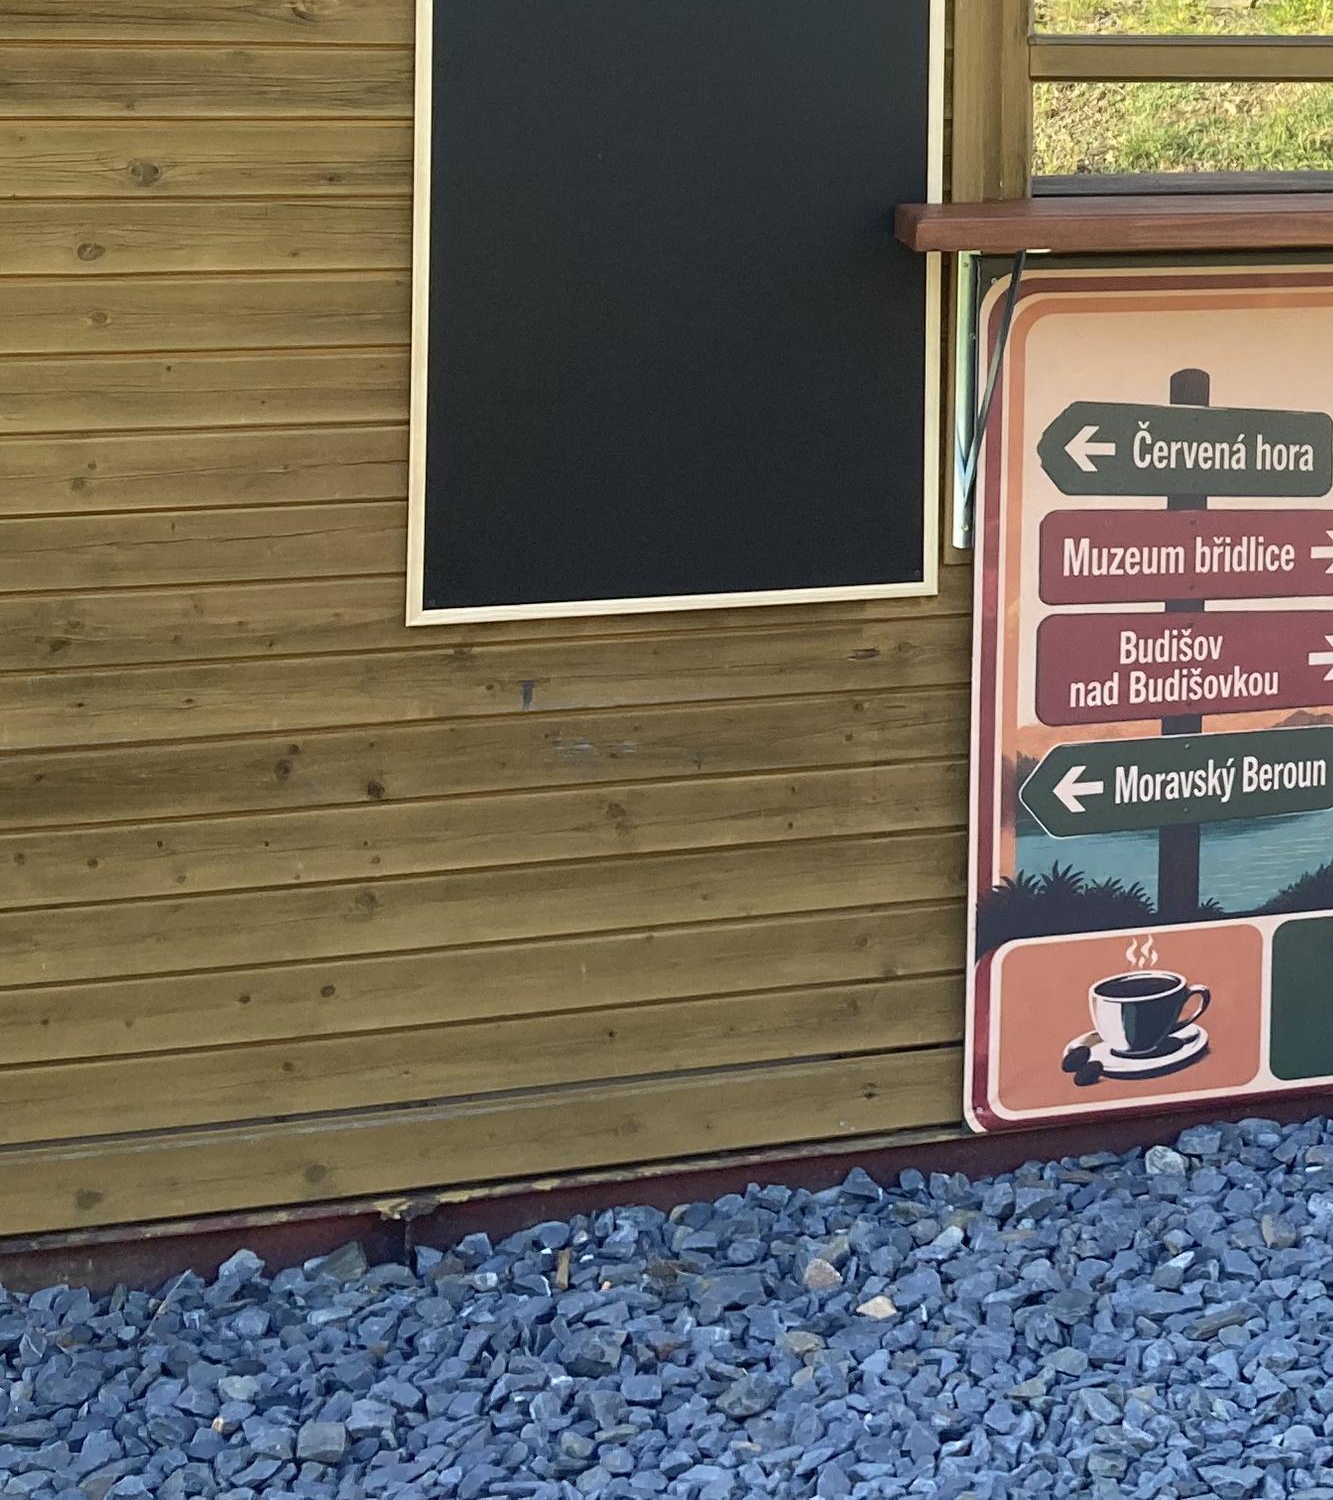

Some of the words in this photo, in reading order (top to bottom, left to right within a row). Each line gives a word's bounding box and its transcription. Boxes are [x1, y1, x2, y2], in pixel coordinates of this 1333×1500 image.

[1134, 421, 1245, 469] Červená
[1257, 435, 1313, 471] hora
[1064, 538, 1184, 576] Muzeum
[1196, 536, 1294, 573] břidlice
[1120, 629, 1222, 664] Budišov
[1069, 671, 1119, 707] nad
[1129, 666, 1279, 704] Budišovkou
[1115, 758, 1235, 803] Moravský
[1243, 757, 1325, 792] Beroun
